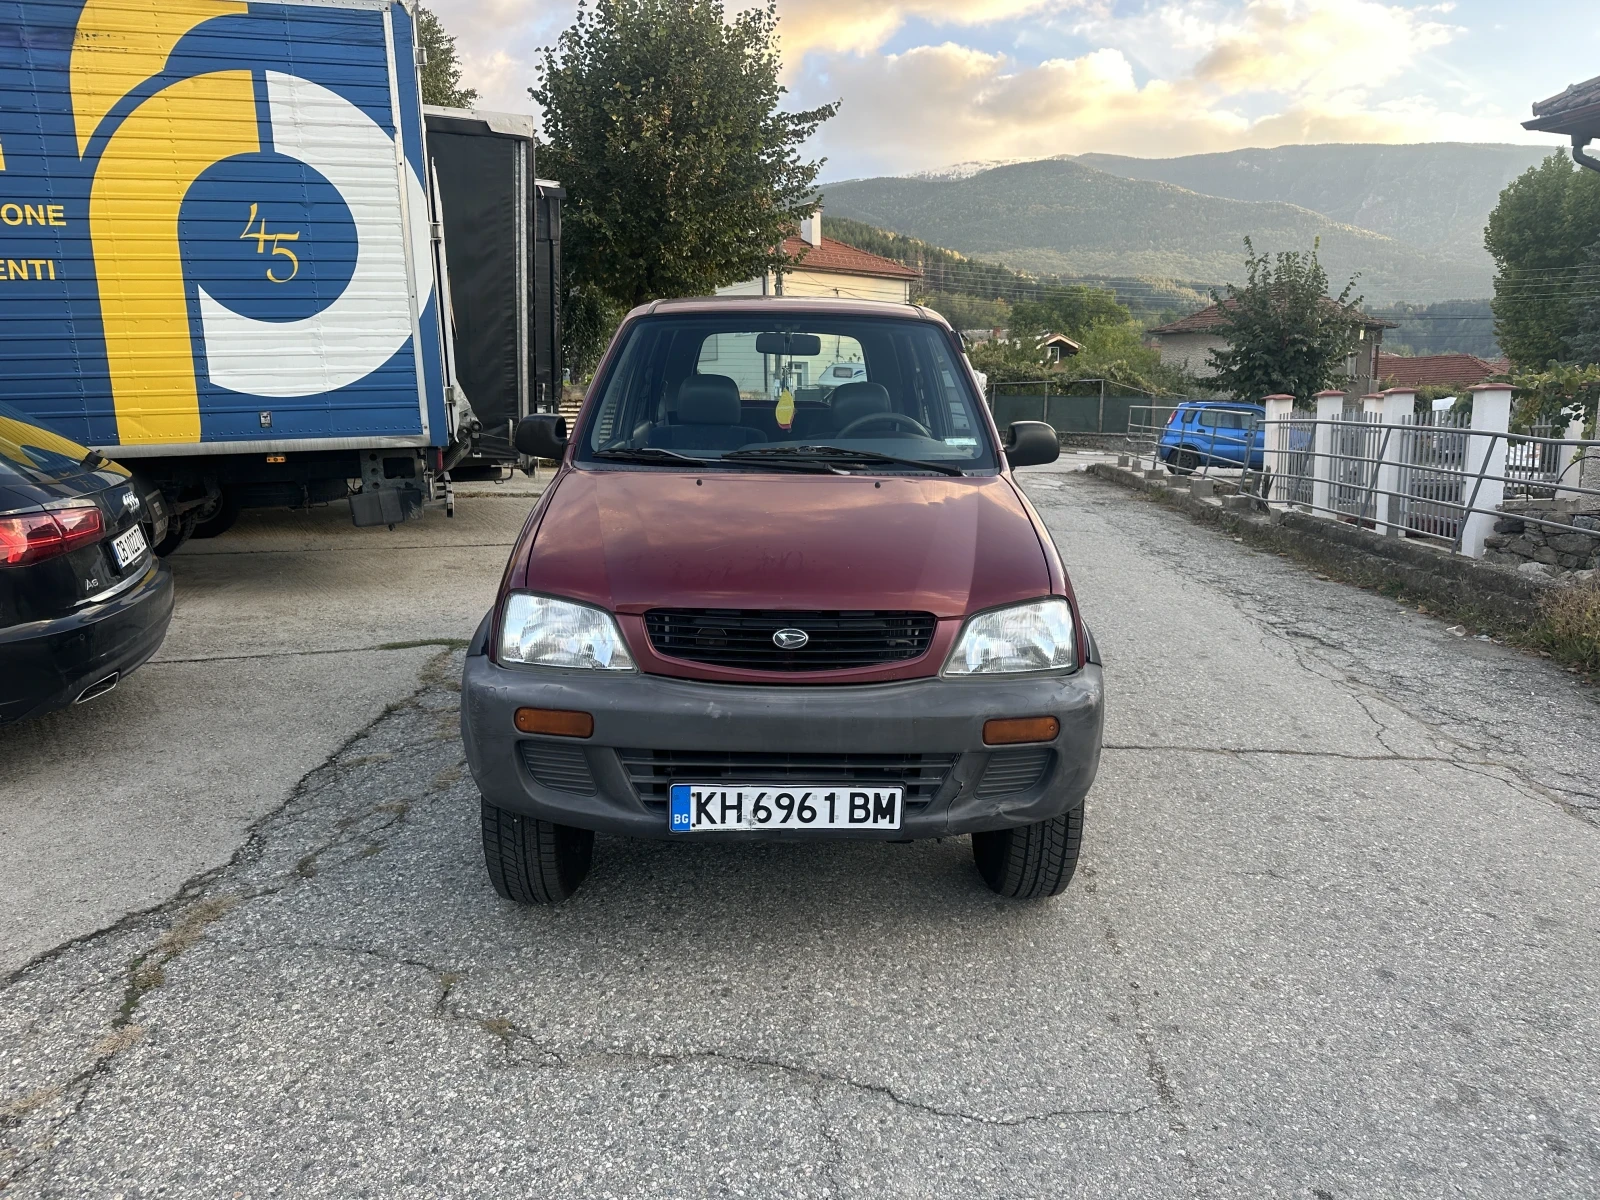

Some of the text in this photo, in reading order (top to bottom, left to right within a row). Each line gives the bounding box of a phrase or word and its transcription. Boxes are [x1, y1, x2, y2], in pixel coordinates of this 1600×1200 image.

[0, 203, 67, 226] ONE
[240, 203, 300, 283] 45
[673, 813, 689, 825] BG
[696, 791, 897, 825] KH 6961 BM
